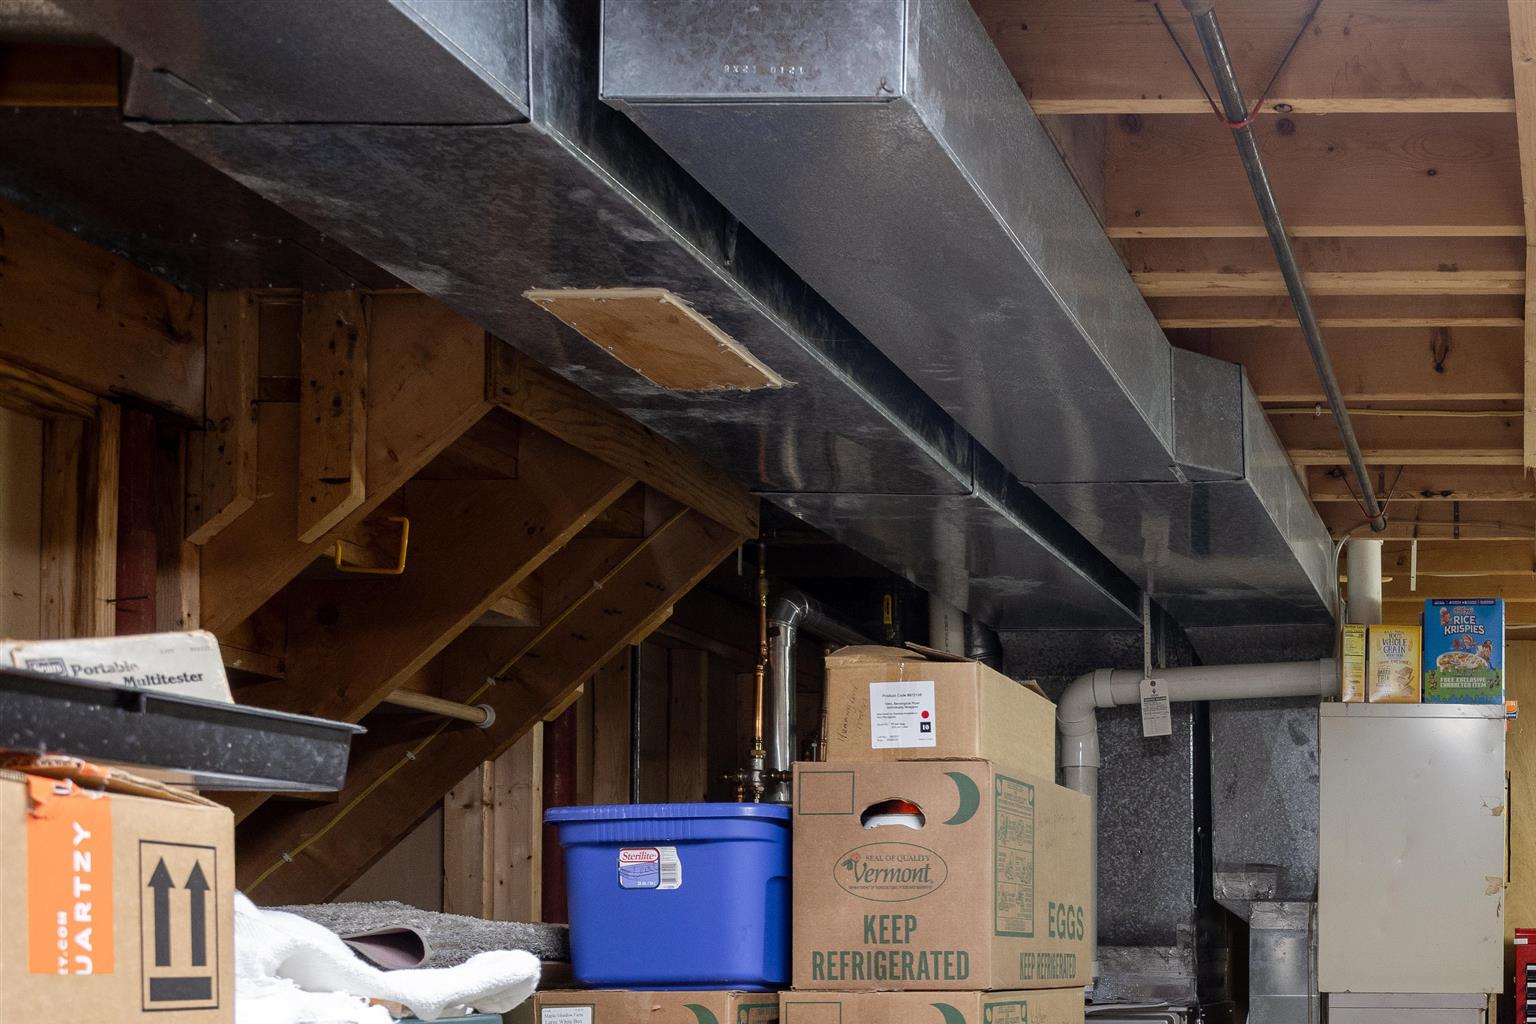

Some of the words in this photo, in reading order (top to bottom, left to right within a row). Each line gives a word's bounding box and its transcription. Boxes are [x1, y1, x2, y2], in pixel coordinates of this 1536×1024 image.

[1453, 615, 1476, 625] RICE
[1444, 625, 1485, 636] KRISPIES
[1382, 638, 1408, 646] WHOLE
[1383, 645, 1406, 654] GRAIN
[70, 659, 139, 677] Portable
[123, 672, 204, 688] Multitester
[622, 851, 654, 860] Sterilite
[897, 855, 931, 863] QUALITY
[854, 862, 932, 884] Vermont
[72, 821, 94, 975] UARTZY
[863, 914, 918, 944] KEEP
[1048, 901, 1084, 941] EGGS
[812, 950, 970, 981] REFRIGERATED
[1019, 952, 1035, 980] KEEP
[1036, 952, 1077, 979] REFRIGERATED
